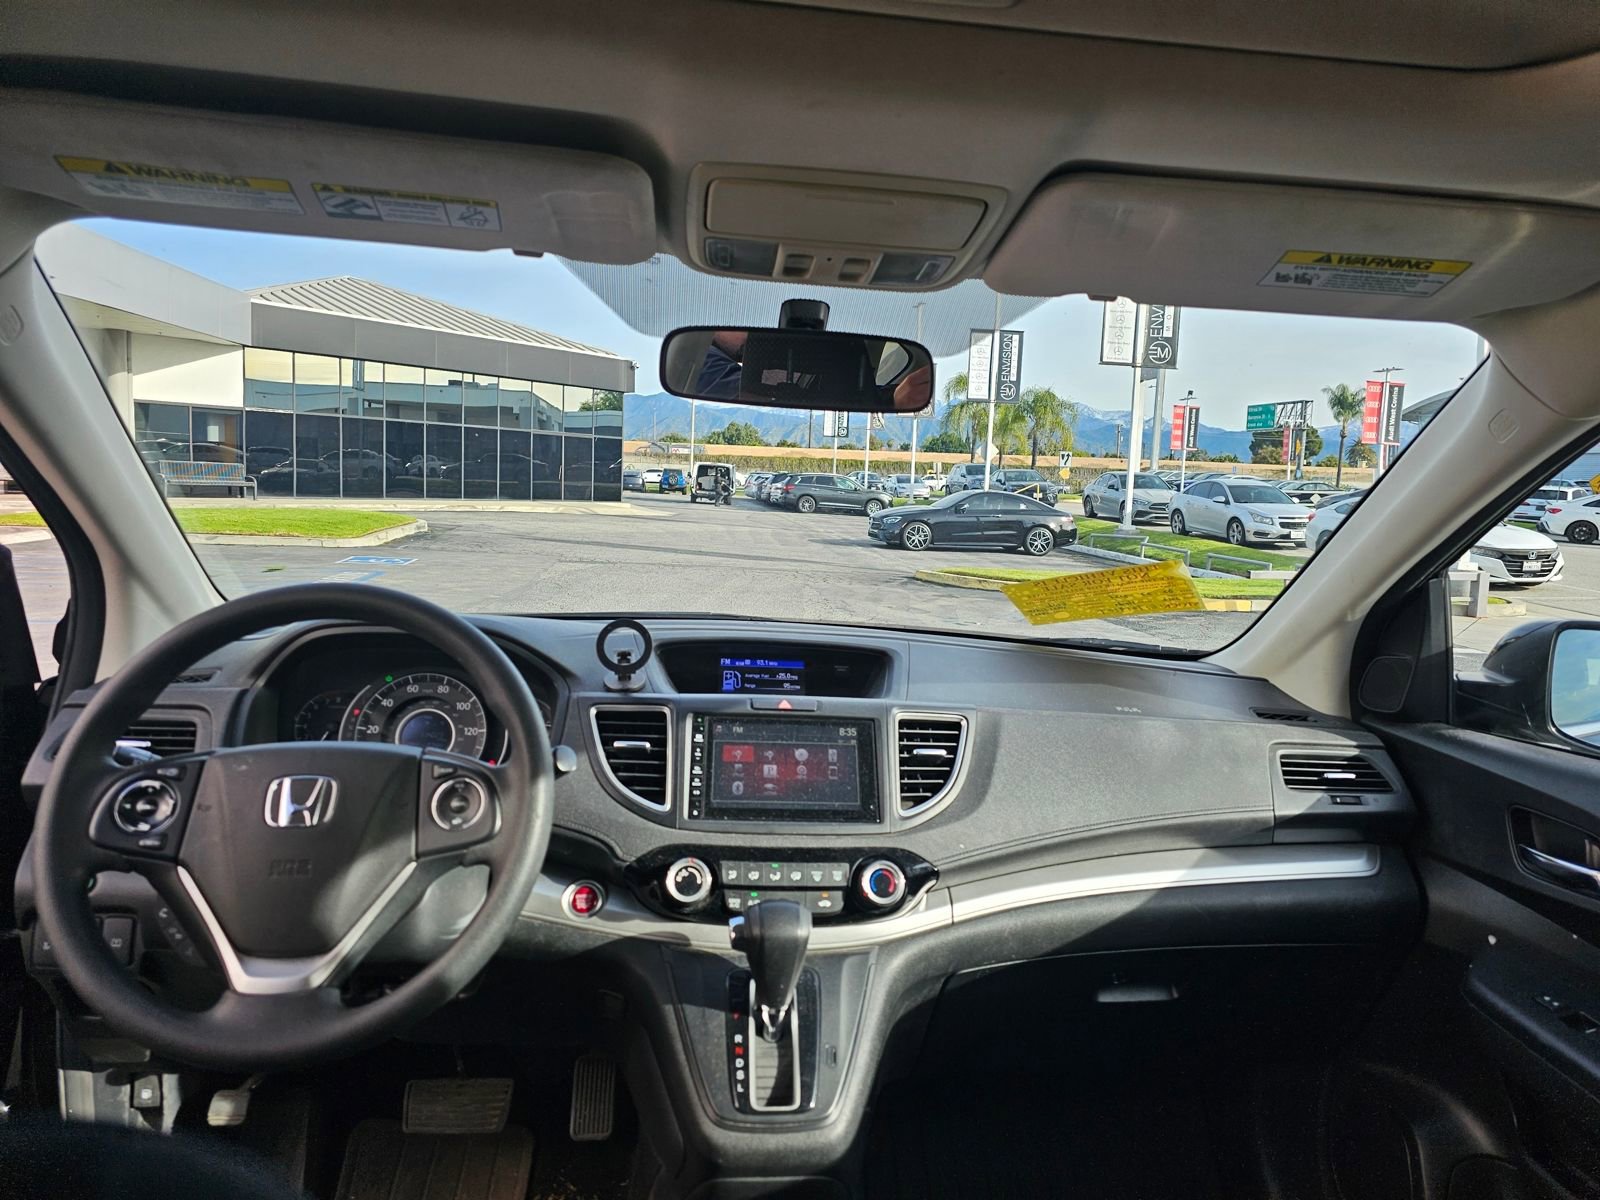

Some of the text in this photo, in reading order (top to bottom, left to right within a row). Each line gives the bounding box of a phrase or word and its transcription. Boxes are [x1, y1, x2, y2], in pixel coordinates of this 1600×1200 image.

[1335, 255, 1434, 270] WARNING
[1150, 304, 1164, 336] ENVI
[1001, 334, 1012, 381] ENVISION
[407, 684, 419, 693] 60
[381, 698, 393, 707] 40
[456, 702, 471, 711] 100
[366, 725, 379, 734] 20
[464, 727, 478, 736] 120
[839, 727, 857, 736] 8:35
[736, 1058, 744, 1068] D
